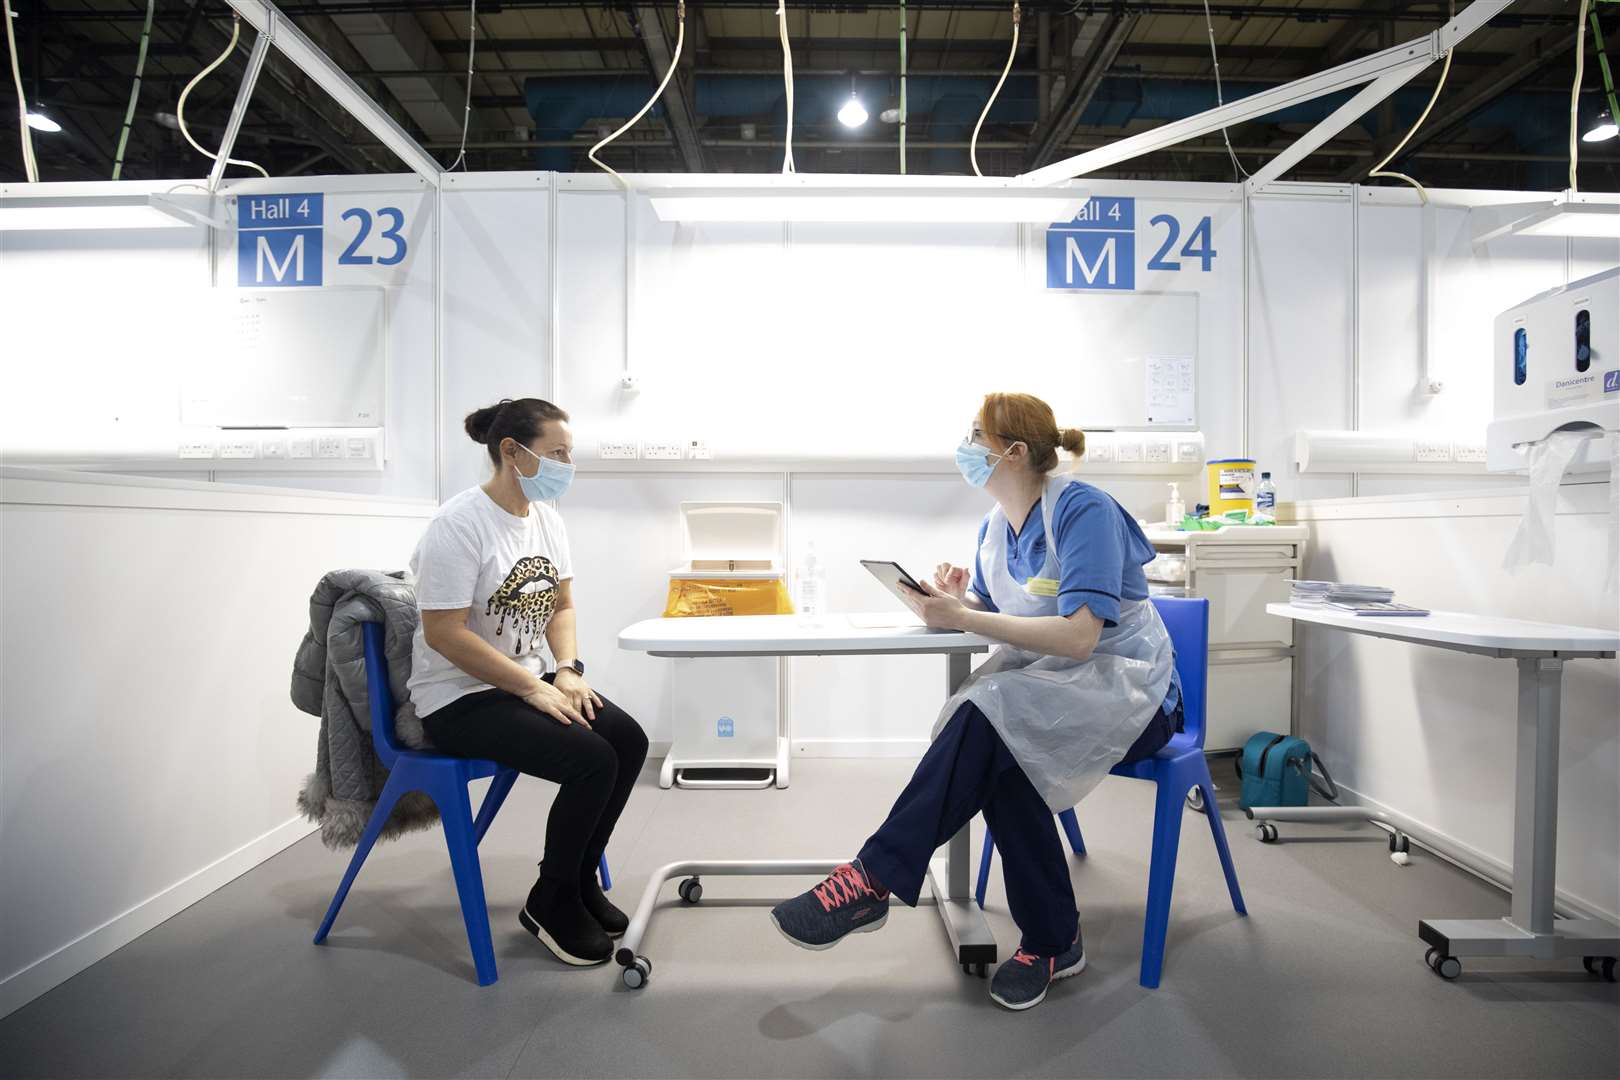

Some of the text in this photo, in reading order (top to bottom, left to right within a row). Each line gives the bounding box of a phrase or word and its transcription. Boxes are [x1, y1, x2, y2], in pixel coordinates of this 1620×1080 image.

[251, 198, 310, 220] Hall 4
[1072, 201, 1121, 222] all 4
[255, 234, 304, 282] M
[338, 207, 407, 265] 23
[1147, 214, 1217, 272] 24
[1065, 237, 1116, 285] M
